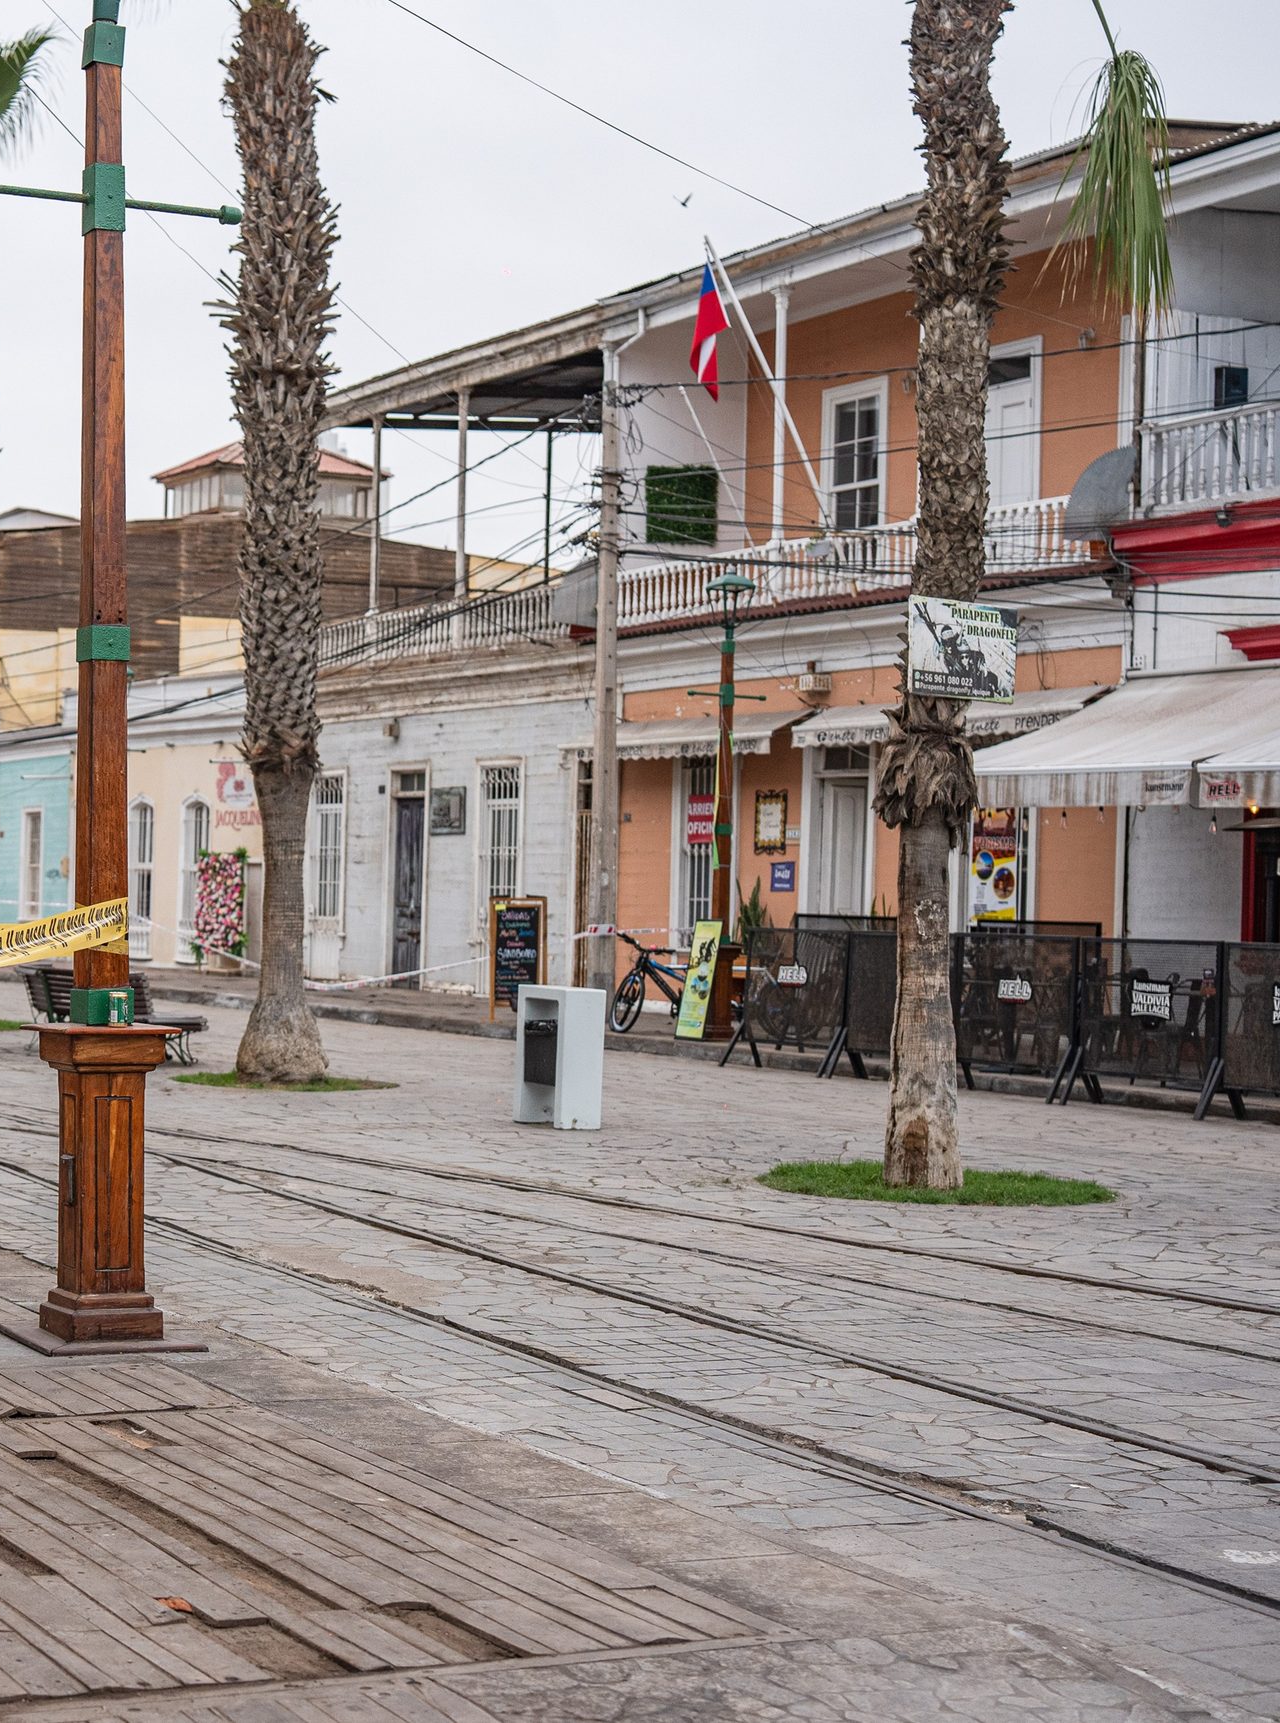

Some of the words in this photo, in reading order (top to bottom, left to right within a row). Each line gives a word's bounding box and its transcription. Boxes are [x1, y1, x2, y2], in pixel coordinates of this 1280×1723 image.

[951, 607, 999, 623] PARAPENTE
[967, 624, 1015, 640] DRAGONFLY
[921, 673, 933, 683] +56
[961, 677, 973, 687] 022
[1209, 784, 1237, 796] HELL
[780, 968, 806, 982] HELL
[1000, 981, 1030, 998] HELL
[1131, 991, 1170, 1007] VALDIVIA
[1131, 1003, 1152, 1012] PALE
[1149, 1005, 1170, 1017] LAGER
